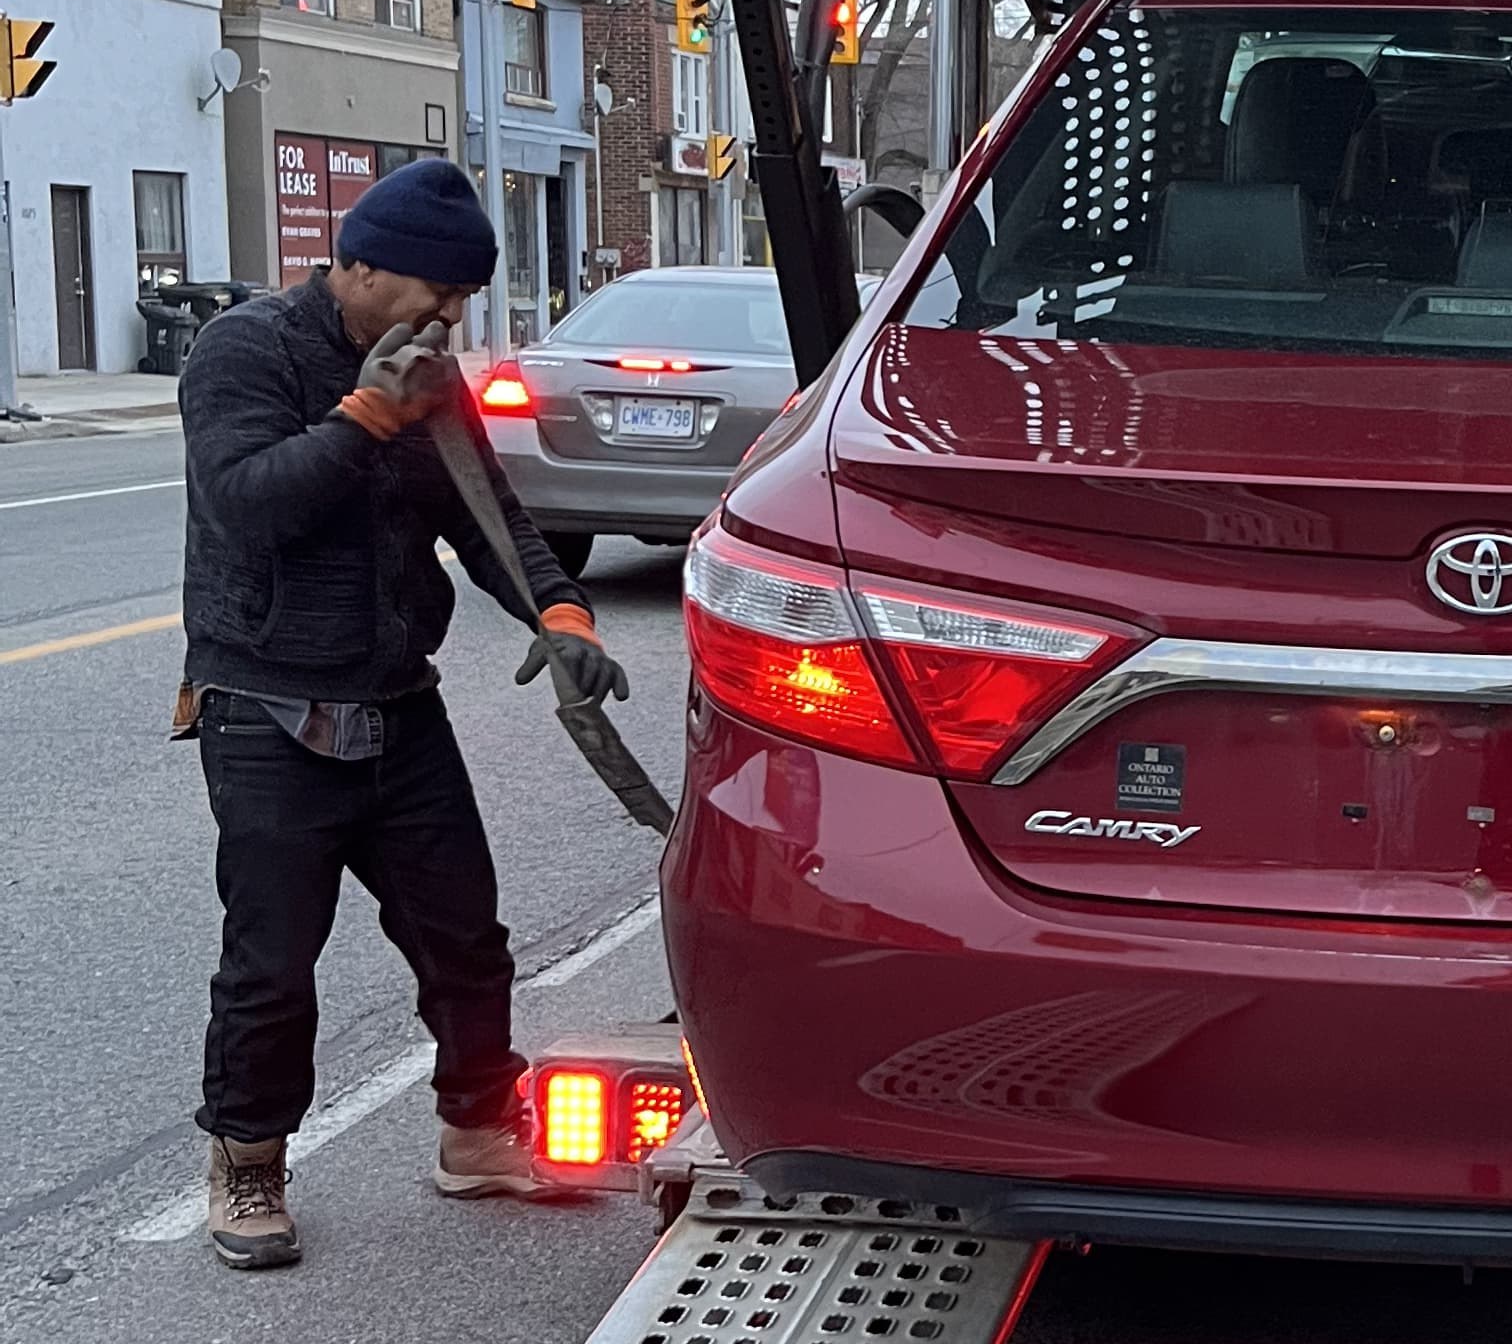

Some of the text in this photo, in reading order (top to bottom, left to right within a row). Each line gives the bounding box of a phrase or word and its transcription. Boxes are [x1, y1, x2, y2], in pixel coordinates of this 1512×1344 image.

[279, 145, 305, 169] FOR
[329, 149, 370, 175] InTrust
[280, 172, 317, 196] LEASE
[1128, 762, 1175, 775] ONTARIO
[1135, 773, 1166, 785] AUTO
[1118, 784, 1182, 797] COLLECTION
[1024, 810, 1202, 848] CAMRY
